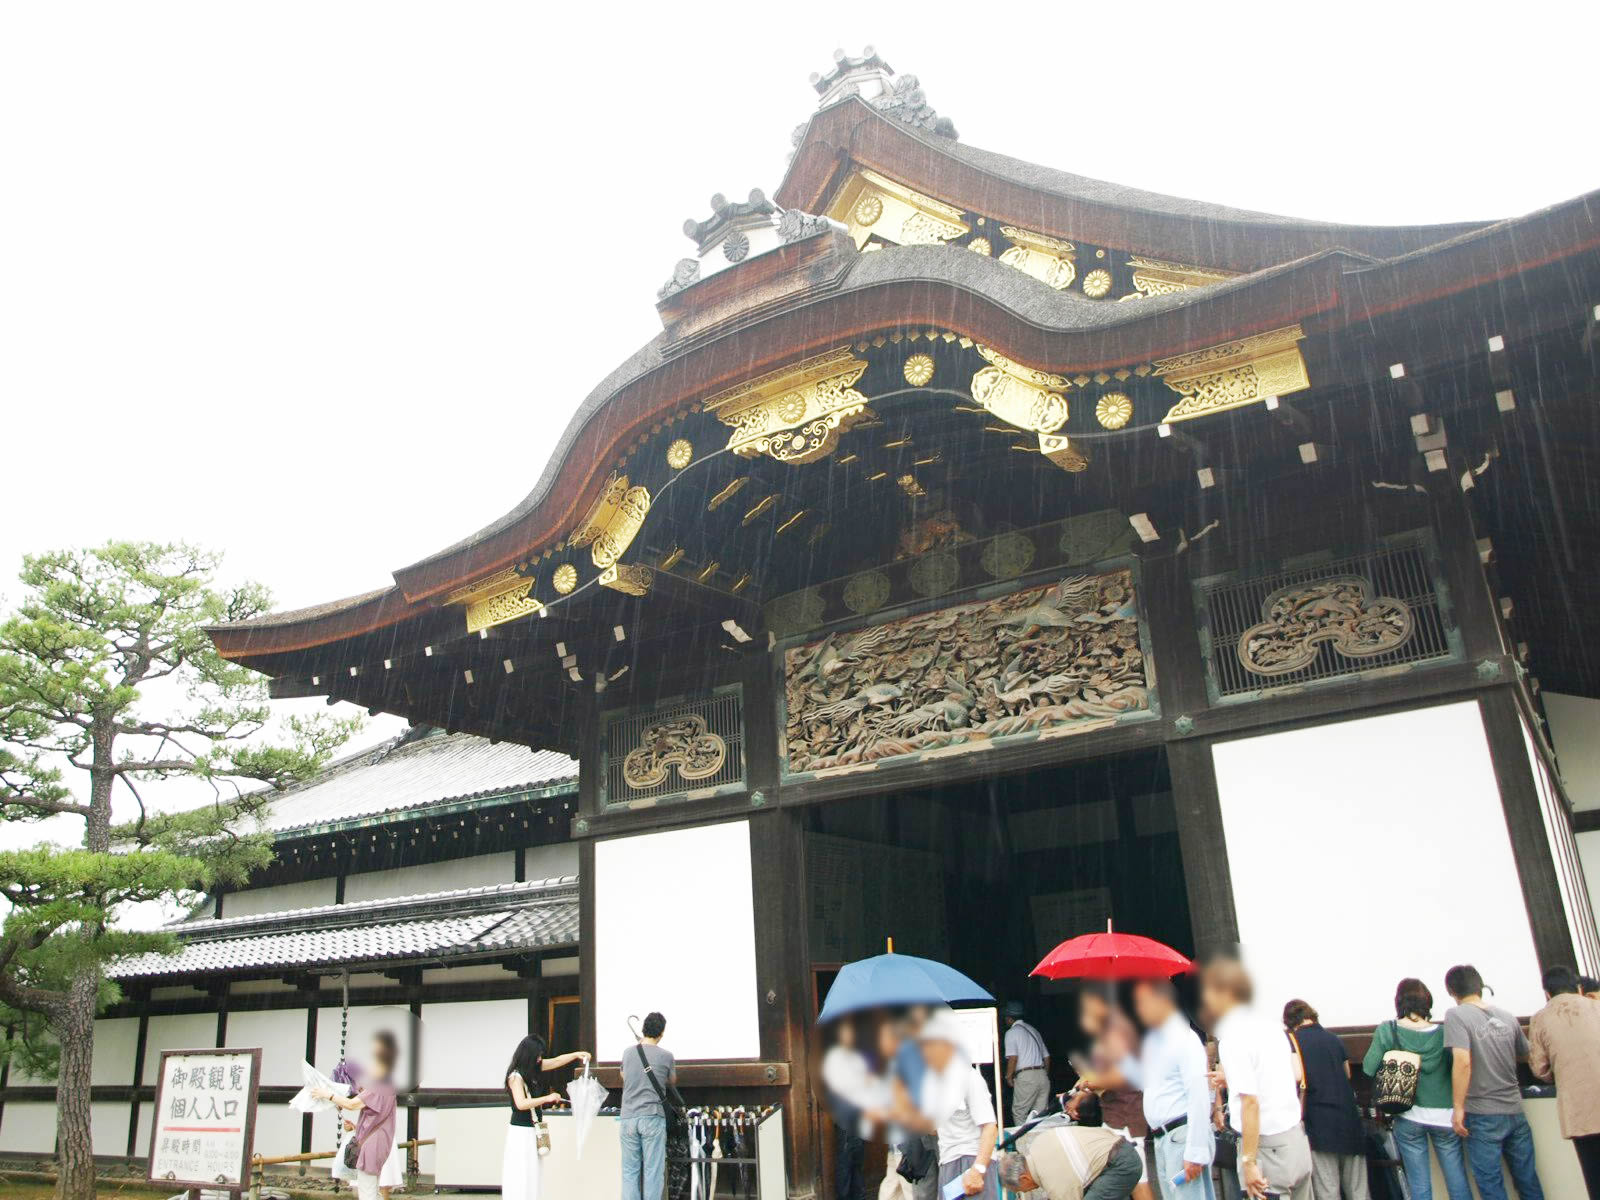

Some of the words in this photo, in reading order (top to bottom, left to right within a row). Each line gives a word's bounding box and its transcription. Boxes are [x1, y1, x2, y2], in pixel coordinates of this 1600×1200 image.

[171, 1065, 245, 1091] 御殿観覧
[171, 1096, 239, 1120] 個人入口
